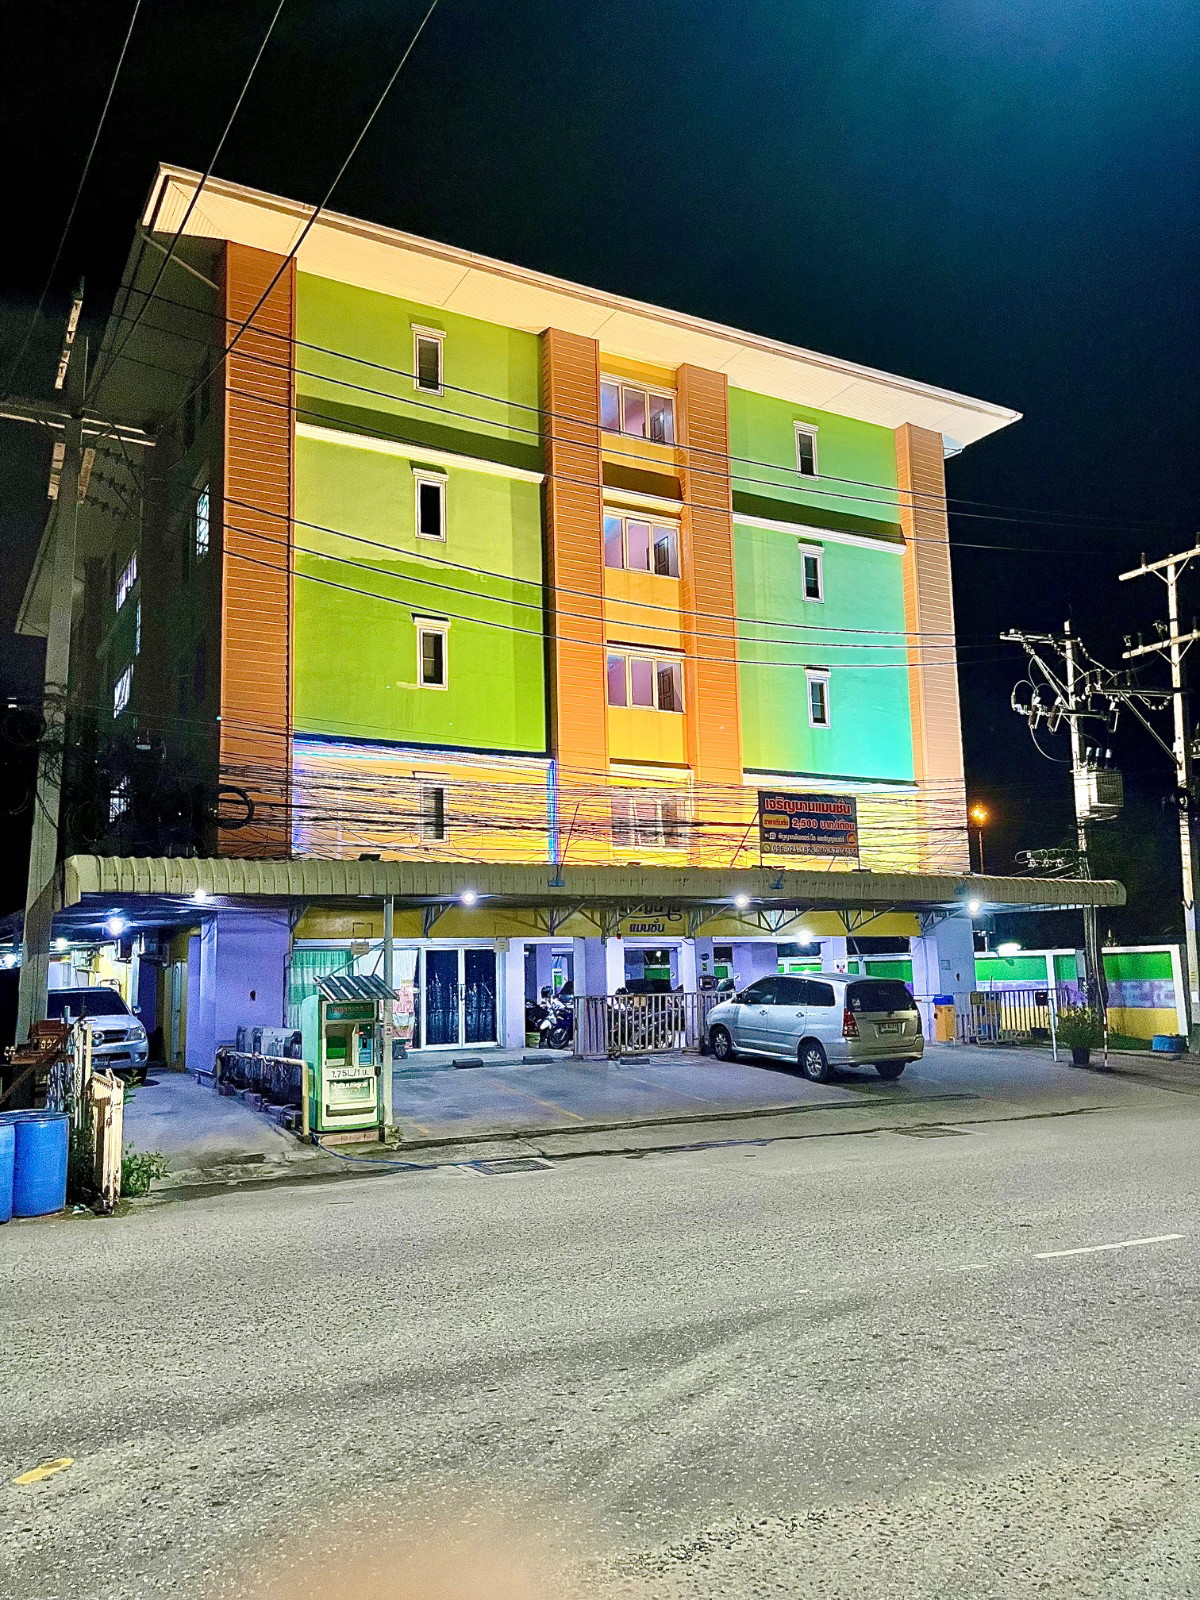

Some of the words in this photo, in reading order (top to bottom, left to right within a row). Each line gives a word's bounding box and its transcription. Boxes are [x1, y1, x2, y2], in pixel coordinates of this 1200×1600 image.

[764, 796, 852, 815] เจริญนานแมนชั่น
[791, 818, 818, 830] 2,500
[630, 918, 665, 932] แมนชั่น
